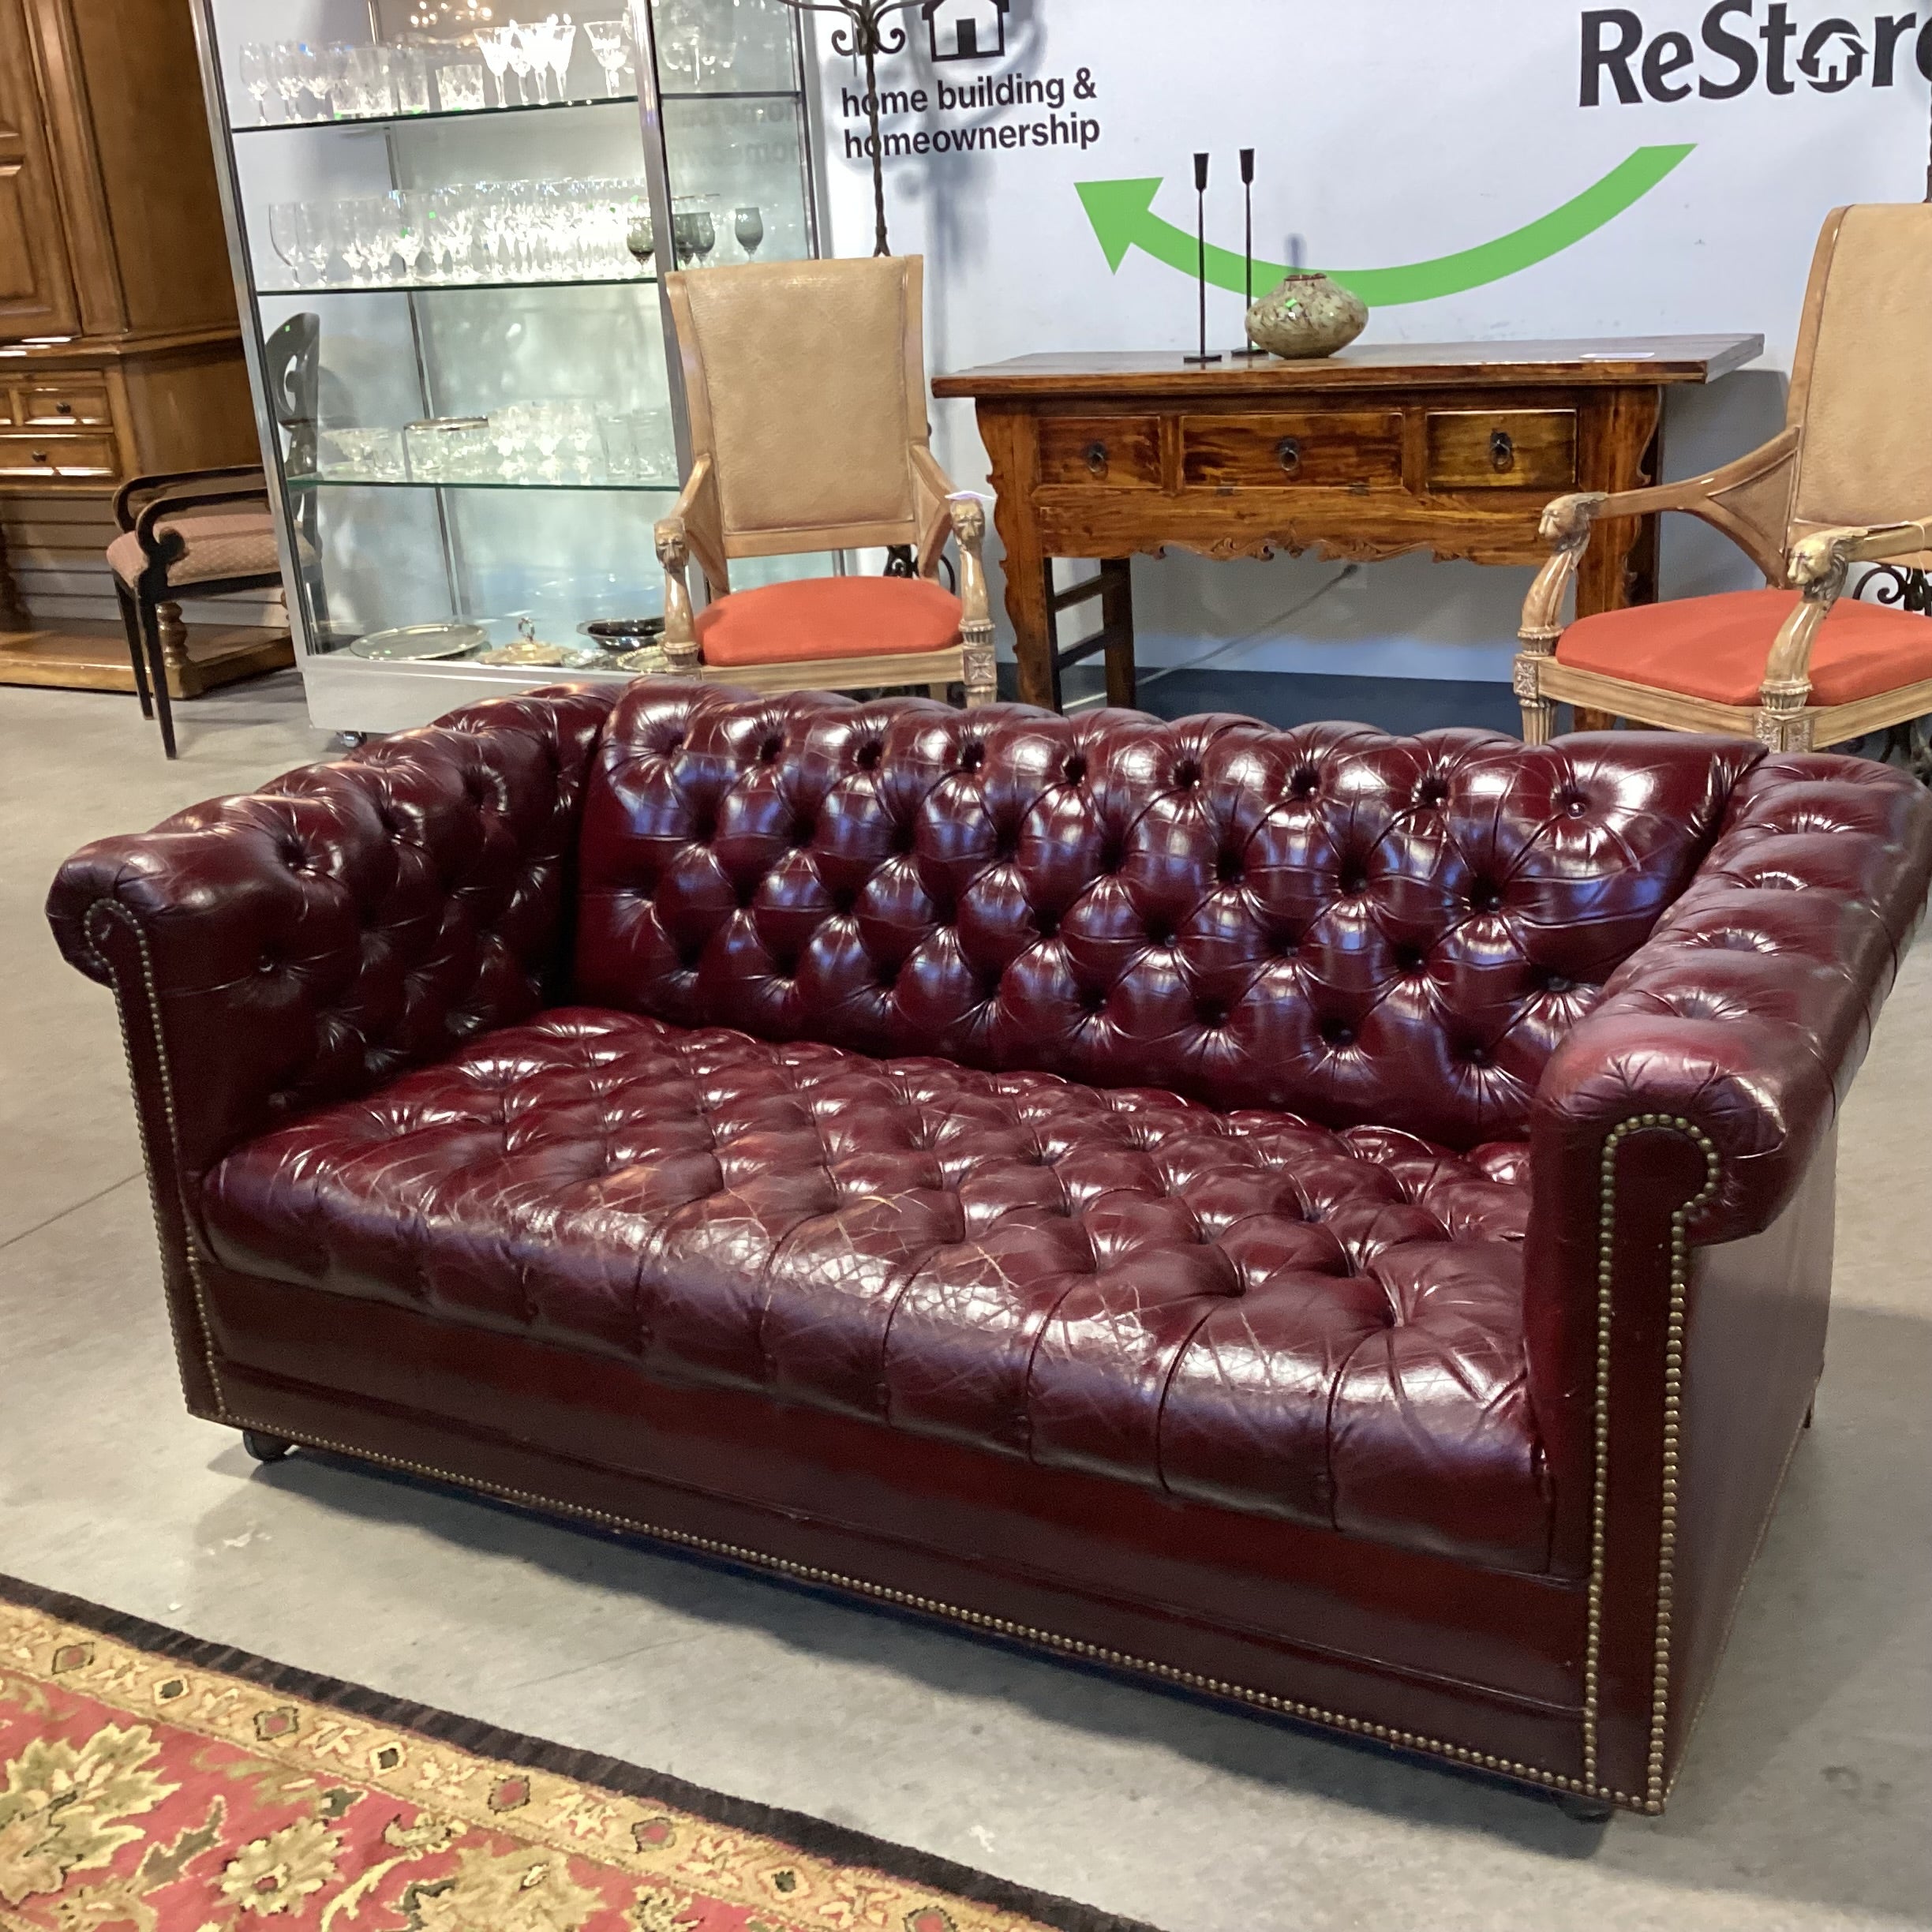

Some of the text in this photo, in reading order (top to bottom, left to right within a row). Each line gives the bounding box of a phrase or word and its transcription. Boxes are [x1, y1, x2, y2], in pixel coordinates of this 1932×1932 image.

[938, 73, 1065, 110] building
[1073, 67, 1098, 99] &
[844, 112, 1100, 159] homeownership
